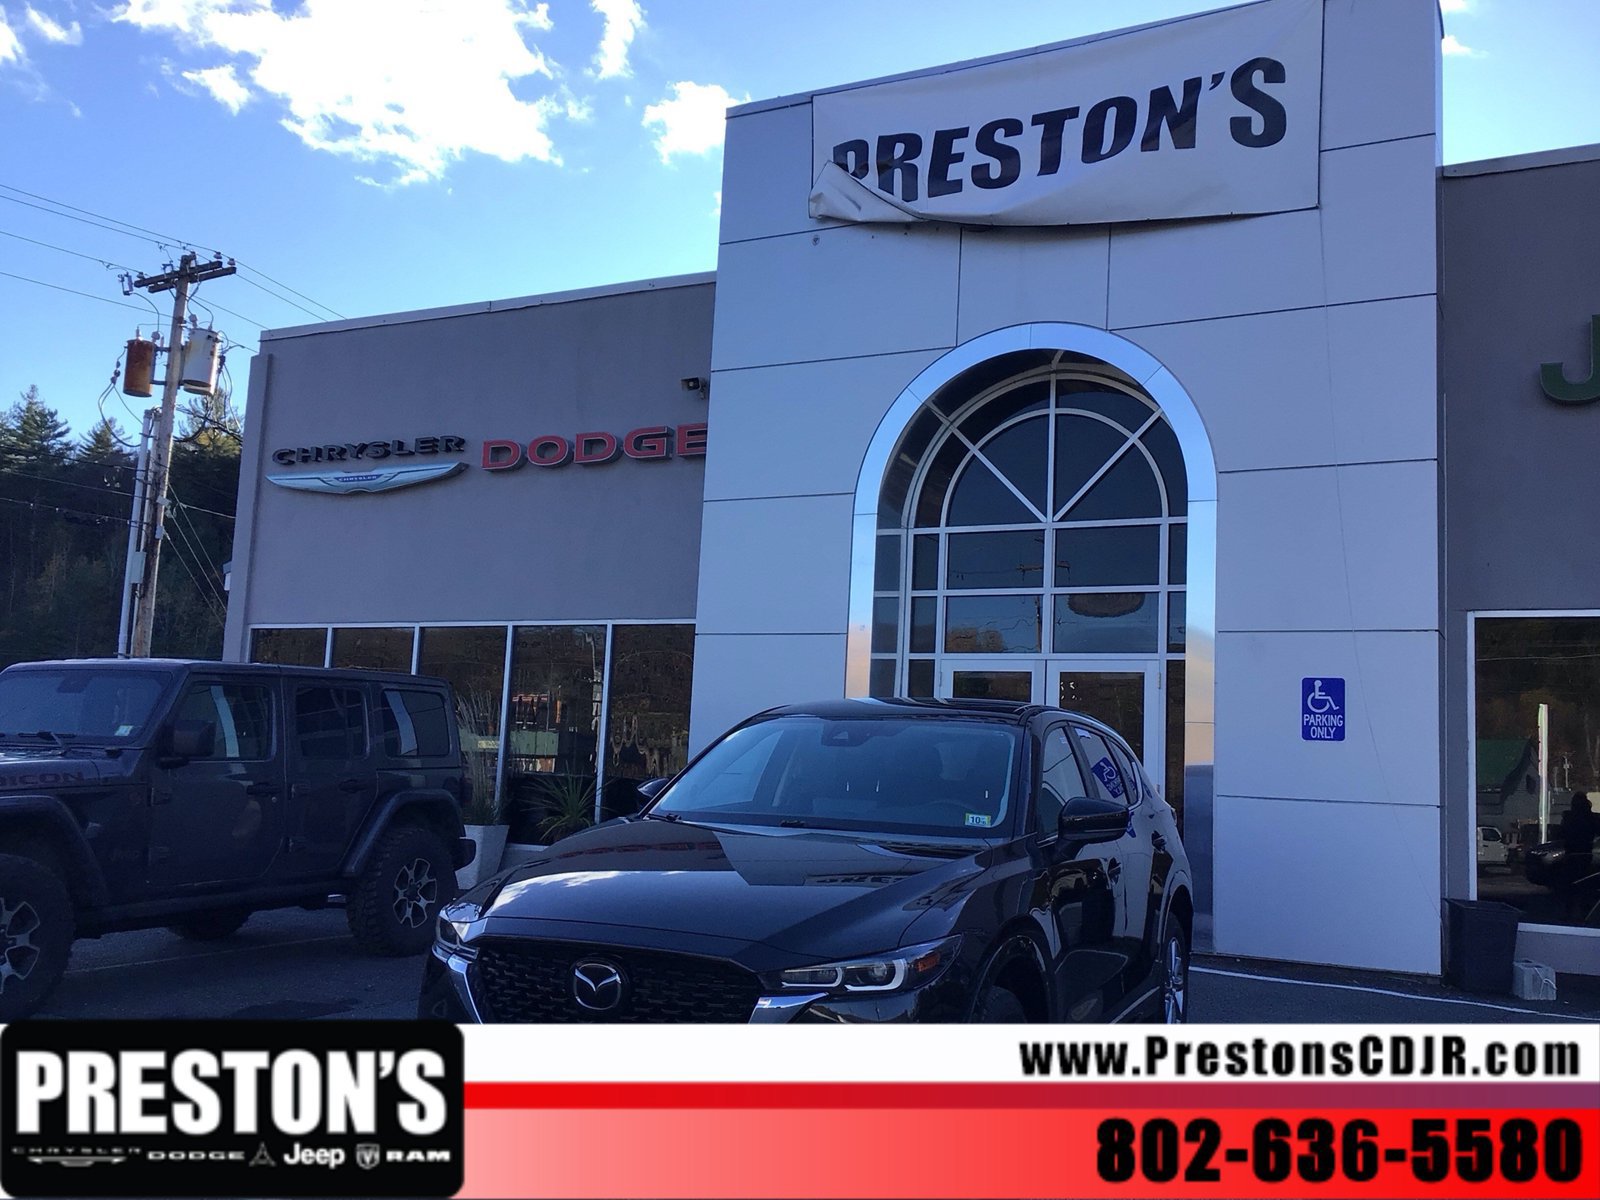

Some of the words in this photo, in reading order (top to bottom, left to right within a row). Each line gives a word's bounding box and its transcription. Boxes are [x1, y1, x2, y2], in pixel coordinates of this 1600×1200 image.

[833, 56, 1287, 203] PRESTON'S
[272, 435, 465, 466] CHRYSLER
[481, 423, 707, 471] DODGE
[1303, 714, 1343, 727] PARKING
[1310, 726, 1336, 739] ONLY
